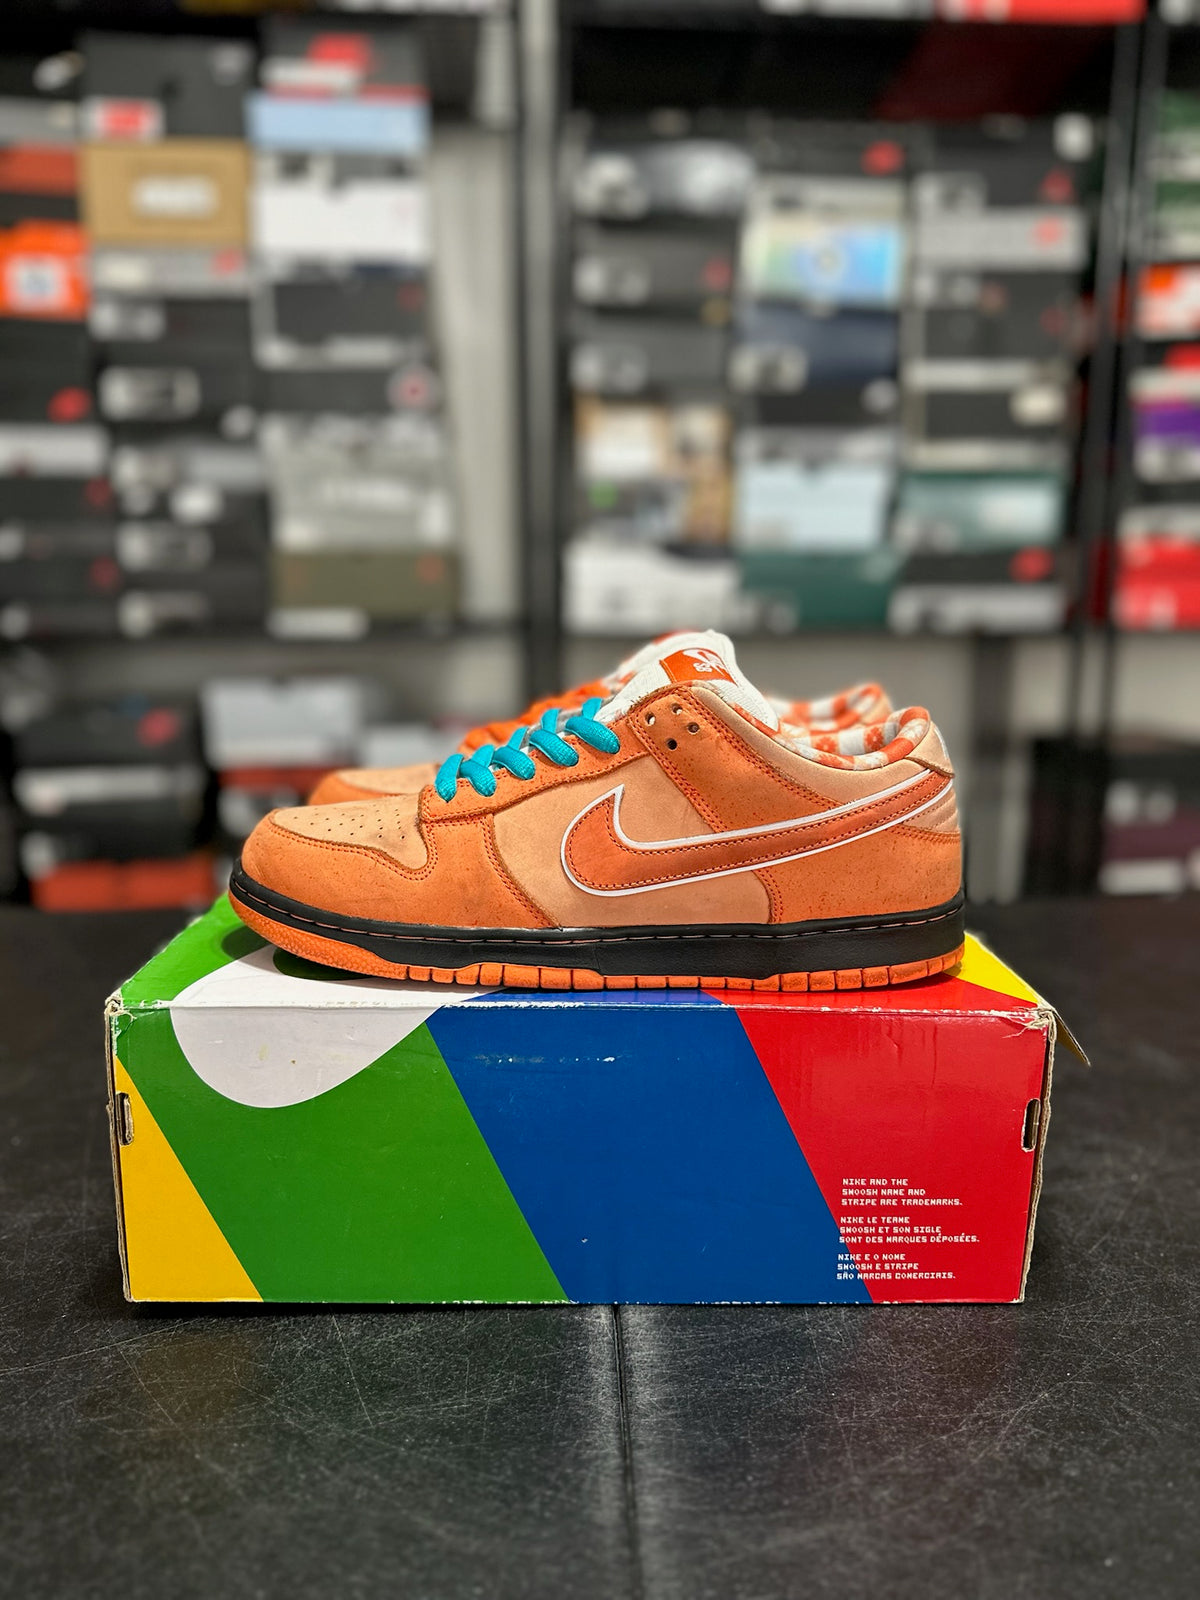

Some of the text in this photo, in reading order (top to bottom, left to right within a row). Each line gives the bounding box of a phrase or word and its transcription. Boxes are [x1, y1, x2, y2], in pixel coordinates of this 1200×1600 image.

[842, 1178, 909, 1186] NIKE AND THE
[841, 1188, 879, 1196] SWOOSH
[880, 1188, 905, 1196] NAME
[841, 1198, 963, 1206] STRIPE ARE TRADEMARKS.
[840, 1216, 865, 1224] NIKE
[866, 1216, 878, 1224] LE
[877, 1226, 890, 1234] ET
[892, 1226, 911, 1234] SON
[913, 1226, 942, 1234] SIGLE
[885, 1235, 928, 1244] MARQUES
[929, 1232, 980, 1243] DÉPOSÉES.
[881, 1253, 906, 1261] NOME
[836, 1271, 855, 1279] SÃO
[856, 1272, 893, 1280] MARCAS
